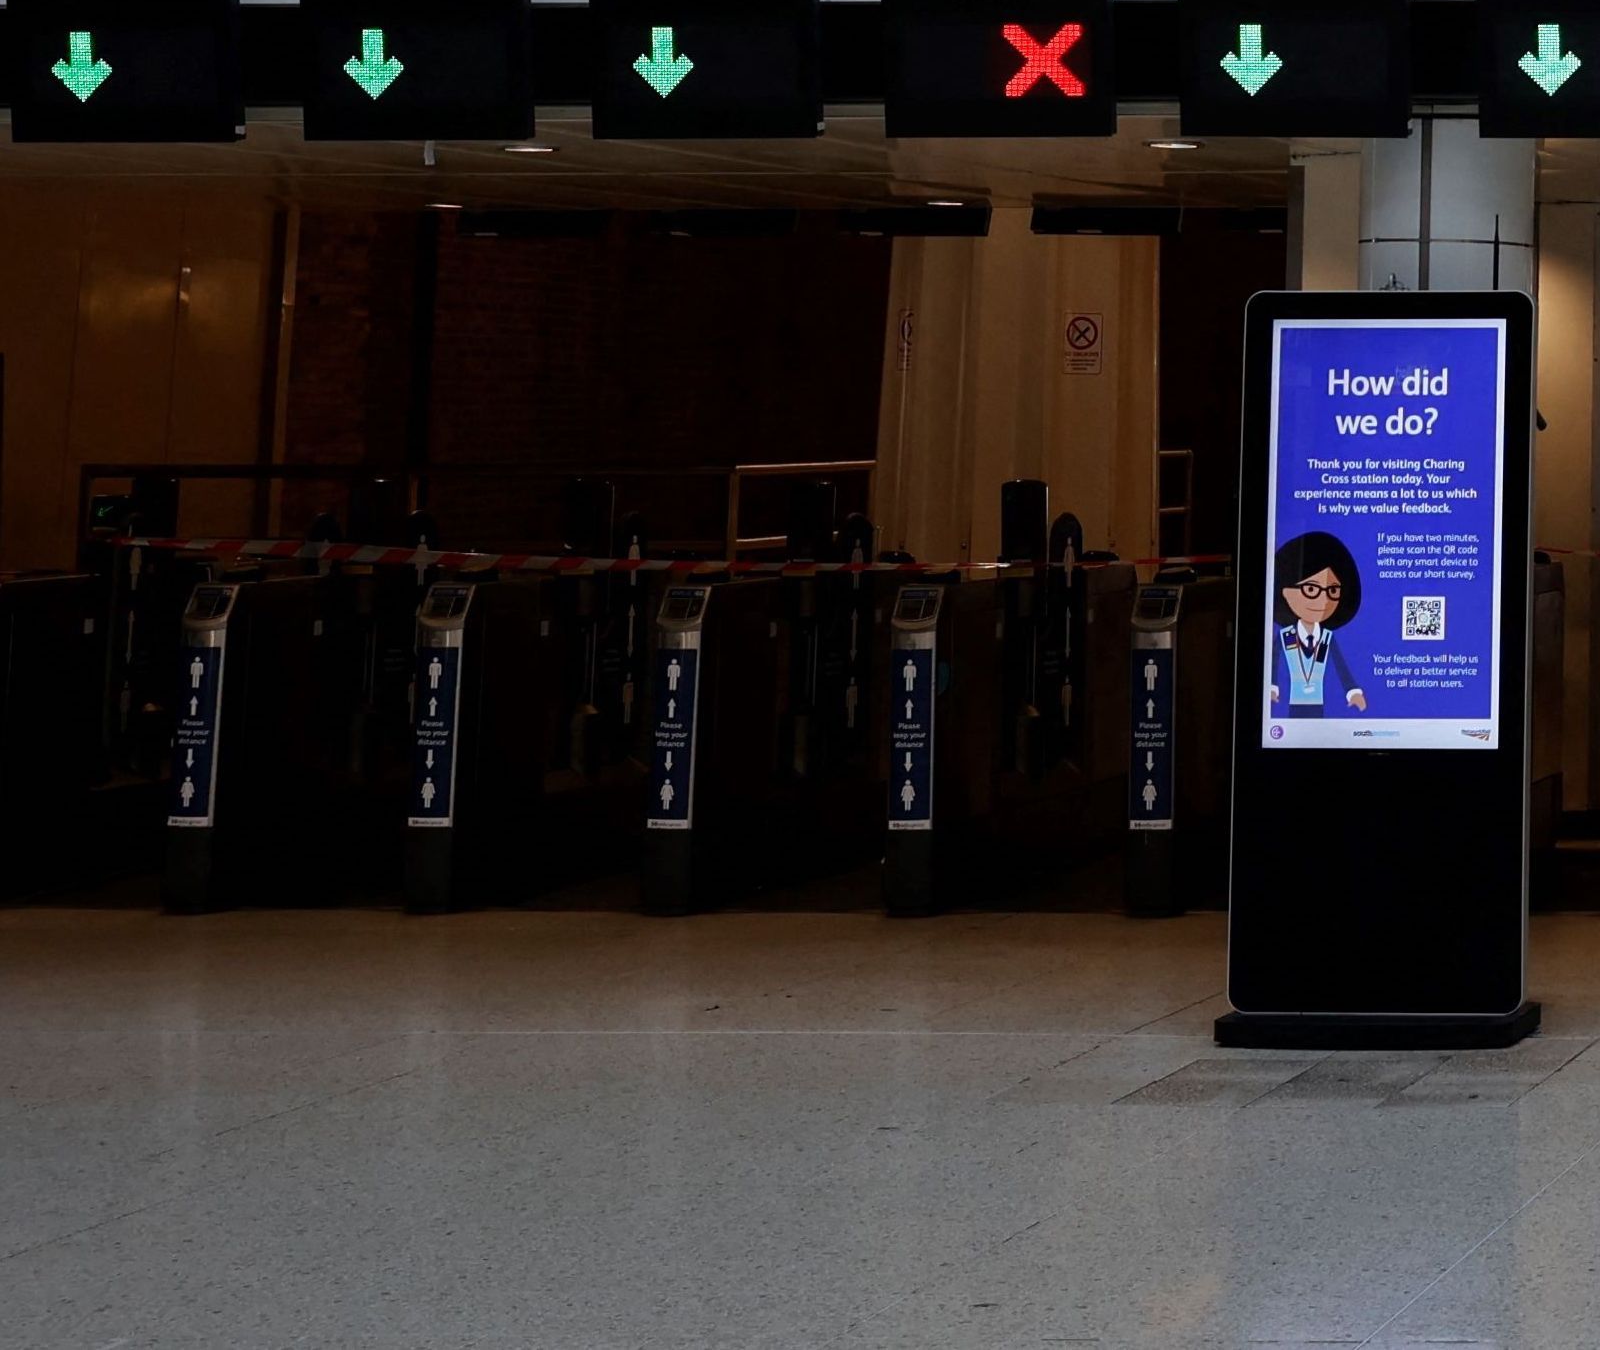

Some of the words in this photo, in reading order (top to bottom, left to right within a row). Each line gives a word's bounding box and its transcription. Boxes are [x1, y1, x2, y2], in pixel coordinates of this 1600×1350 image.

[1327, 368, 1395, 397] How
[1402, 368, 1449, 396] did
[1335, 414, 1378, 435] we
[1385, 406, 1438, 435] do?
[1307, 458, 1340, 469] Thank
[1343, 461, 1363, 472] you
[1365, 458, 1380, 469] for
[1382, 458, 1421, 472] visiting
[1423, 458, 1465, 472] Charing
[1321, 473, 1349, 484] Cross
[1351, 473, 1389, 484] station
[1391, 473, 1424, 487] today.
[1426, 473, 1451, 484] Your
[1294, 488, 1351, 500] experience
[1353, 490, 1389, 499] means
[1390, 490, 1398, 499] a
[1400, 488, 1415, 499] lot
[1417, 489, 1429, 499] to
[1431, 490, 1444, 499] us
[1446, 488, 1477, 499] which
[1318, 503, 1327, 513] is
[1329, 503, 1351, 516] why
[1353, 505, 1368, 514] we
[1370, 503, 1399, 514] value
[1401, 503, 1452, 514] feedback.
[1377, 533, 1385, 542] If
[1386, 534, 1402, 544] you
[1404, 533, 1424, 542] have
[1426, 534, 1442, 542] two
[1443, 533, 1480, 543] minutes,
[1377, 545, 1405, 556] please
[1406, 546, 1426, 554] scan
[1427, 545, 1441, 554] the
[1443, 545, 1456, 555] QR
[1457, 545, 1478, 554] code
[1377, 558, 1395, 566] with
[1397, 559, 1414, 568] any
[1415, 558, 1438, 566] smart
[1440, 557, 1468, 566] device
[1469, 558, 1478, 566] to
[1379, 570, 1407, 578] access
[1408, 570, 1422, 578] our
[1423, 569, 1445, 578] short
[1447, 570, 1475, 581] survey.
